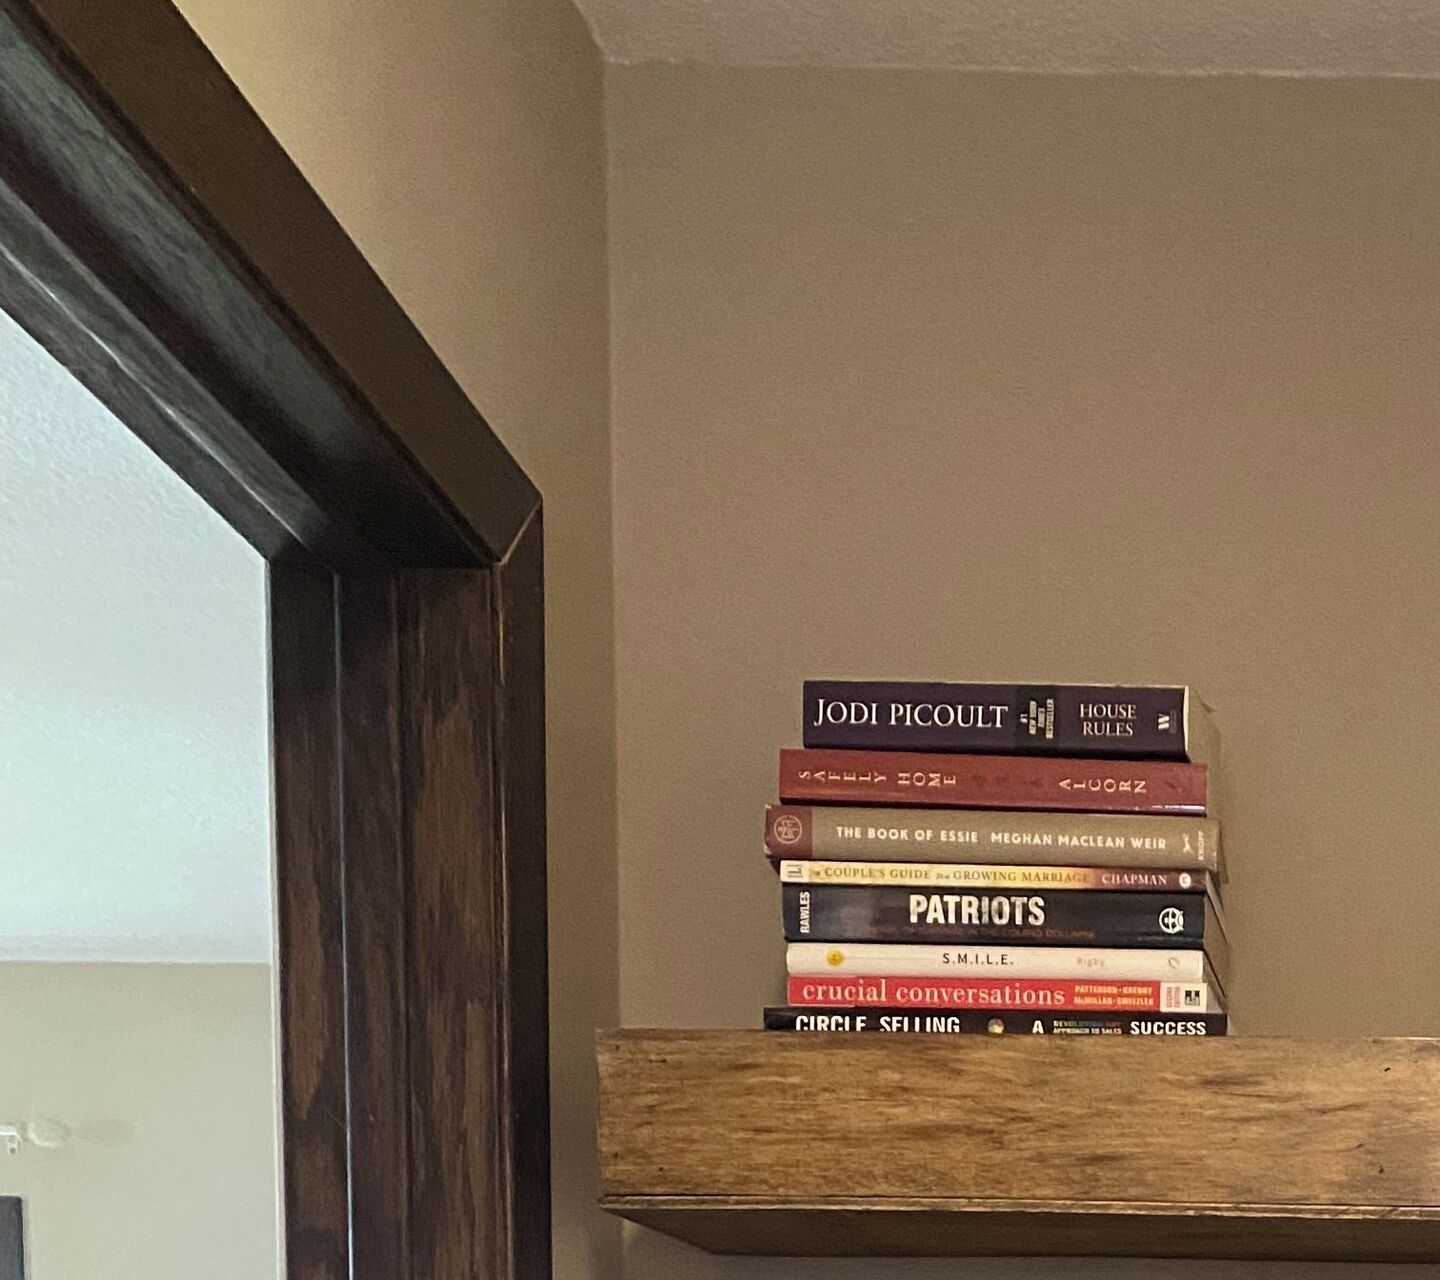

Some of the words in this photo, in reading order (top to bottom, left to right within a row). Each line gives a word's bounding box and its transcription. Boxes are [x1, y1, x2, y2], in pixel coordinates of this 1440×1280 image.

[814, 699, 878, 727] JODI
[889, 703, 1009, 728] PICOULT
[1079, 703, 1137, 719] HOUSE
[1082, 721, 1134, 737] RULES
[799, 770, 887, 783] SAFELY
[898, 771, 956, 788] HOME
[1059, 778, 1147, 794] ALCORN
[836, 826, 862, 838] THE
[868, 827, 909, 841] BOOK
[914, 829, 933, 842] OF
[940, 830, 978, 843] ESSIE
[991, 832, 1052, 845] MEGHAN
[1058, 834, 1125, 849] MACLEAN
[1131, 837, 1166, 850] WEIR
[824, 866, 885, 879] COUPLE'S
[890, 868, 931, 881] GUIDE
[953, 869, 1017, 883] GROWING
[1022, 871, 1089, 884] MARRIAGE
[1101, 873, 1168, 887] CHAPMAN
[799, 891, 811, 934] RAWLES
[909, 894, 1045, 927] PATRIOTS
[942, 953, 1014, 967] S.M.I.L.E.
[802, 979, 887, 1002] crucial
[896, 982, 1066, 1006] conversations
[1032, 1020, 1044, 1034] A
[1130, 1021, 1207, 1036] SUCCESS
